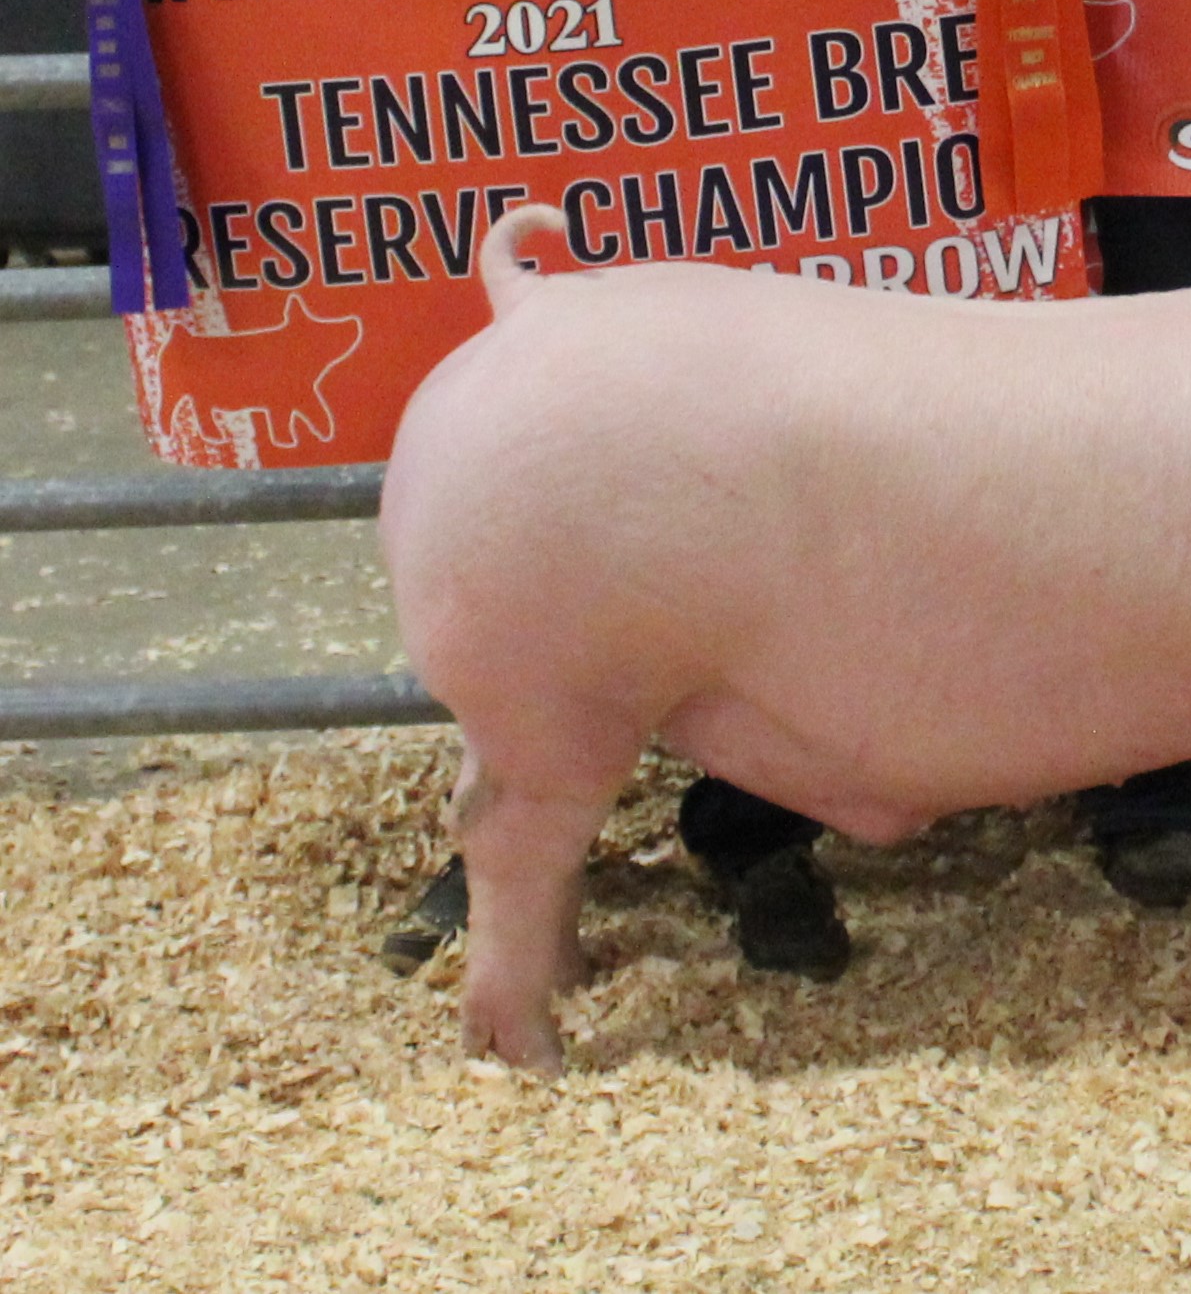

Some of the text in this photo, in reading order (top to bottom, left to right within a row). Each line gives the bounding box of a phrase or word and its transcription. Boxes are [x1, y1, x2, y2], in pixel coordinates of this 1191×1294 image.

[261, 14, 980, 173] TENNESSEE BRE
[562, 132, 986, 266] CHAMPIO
